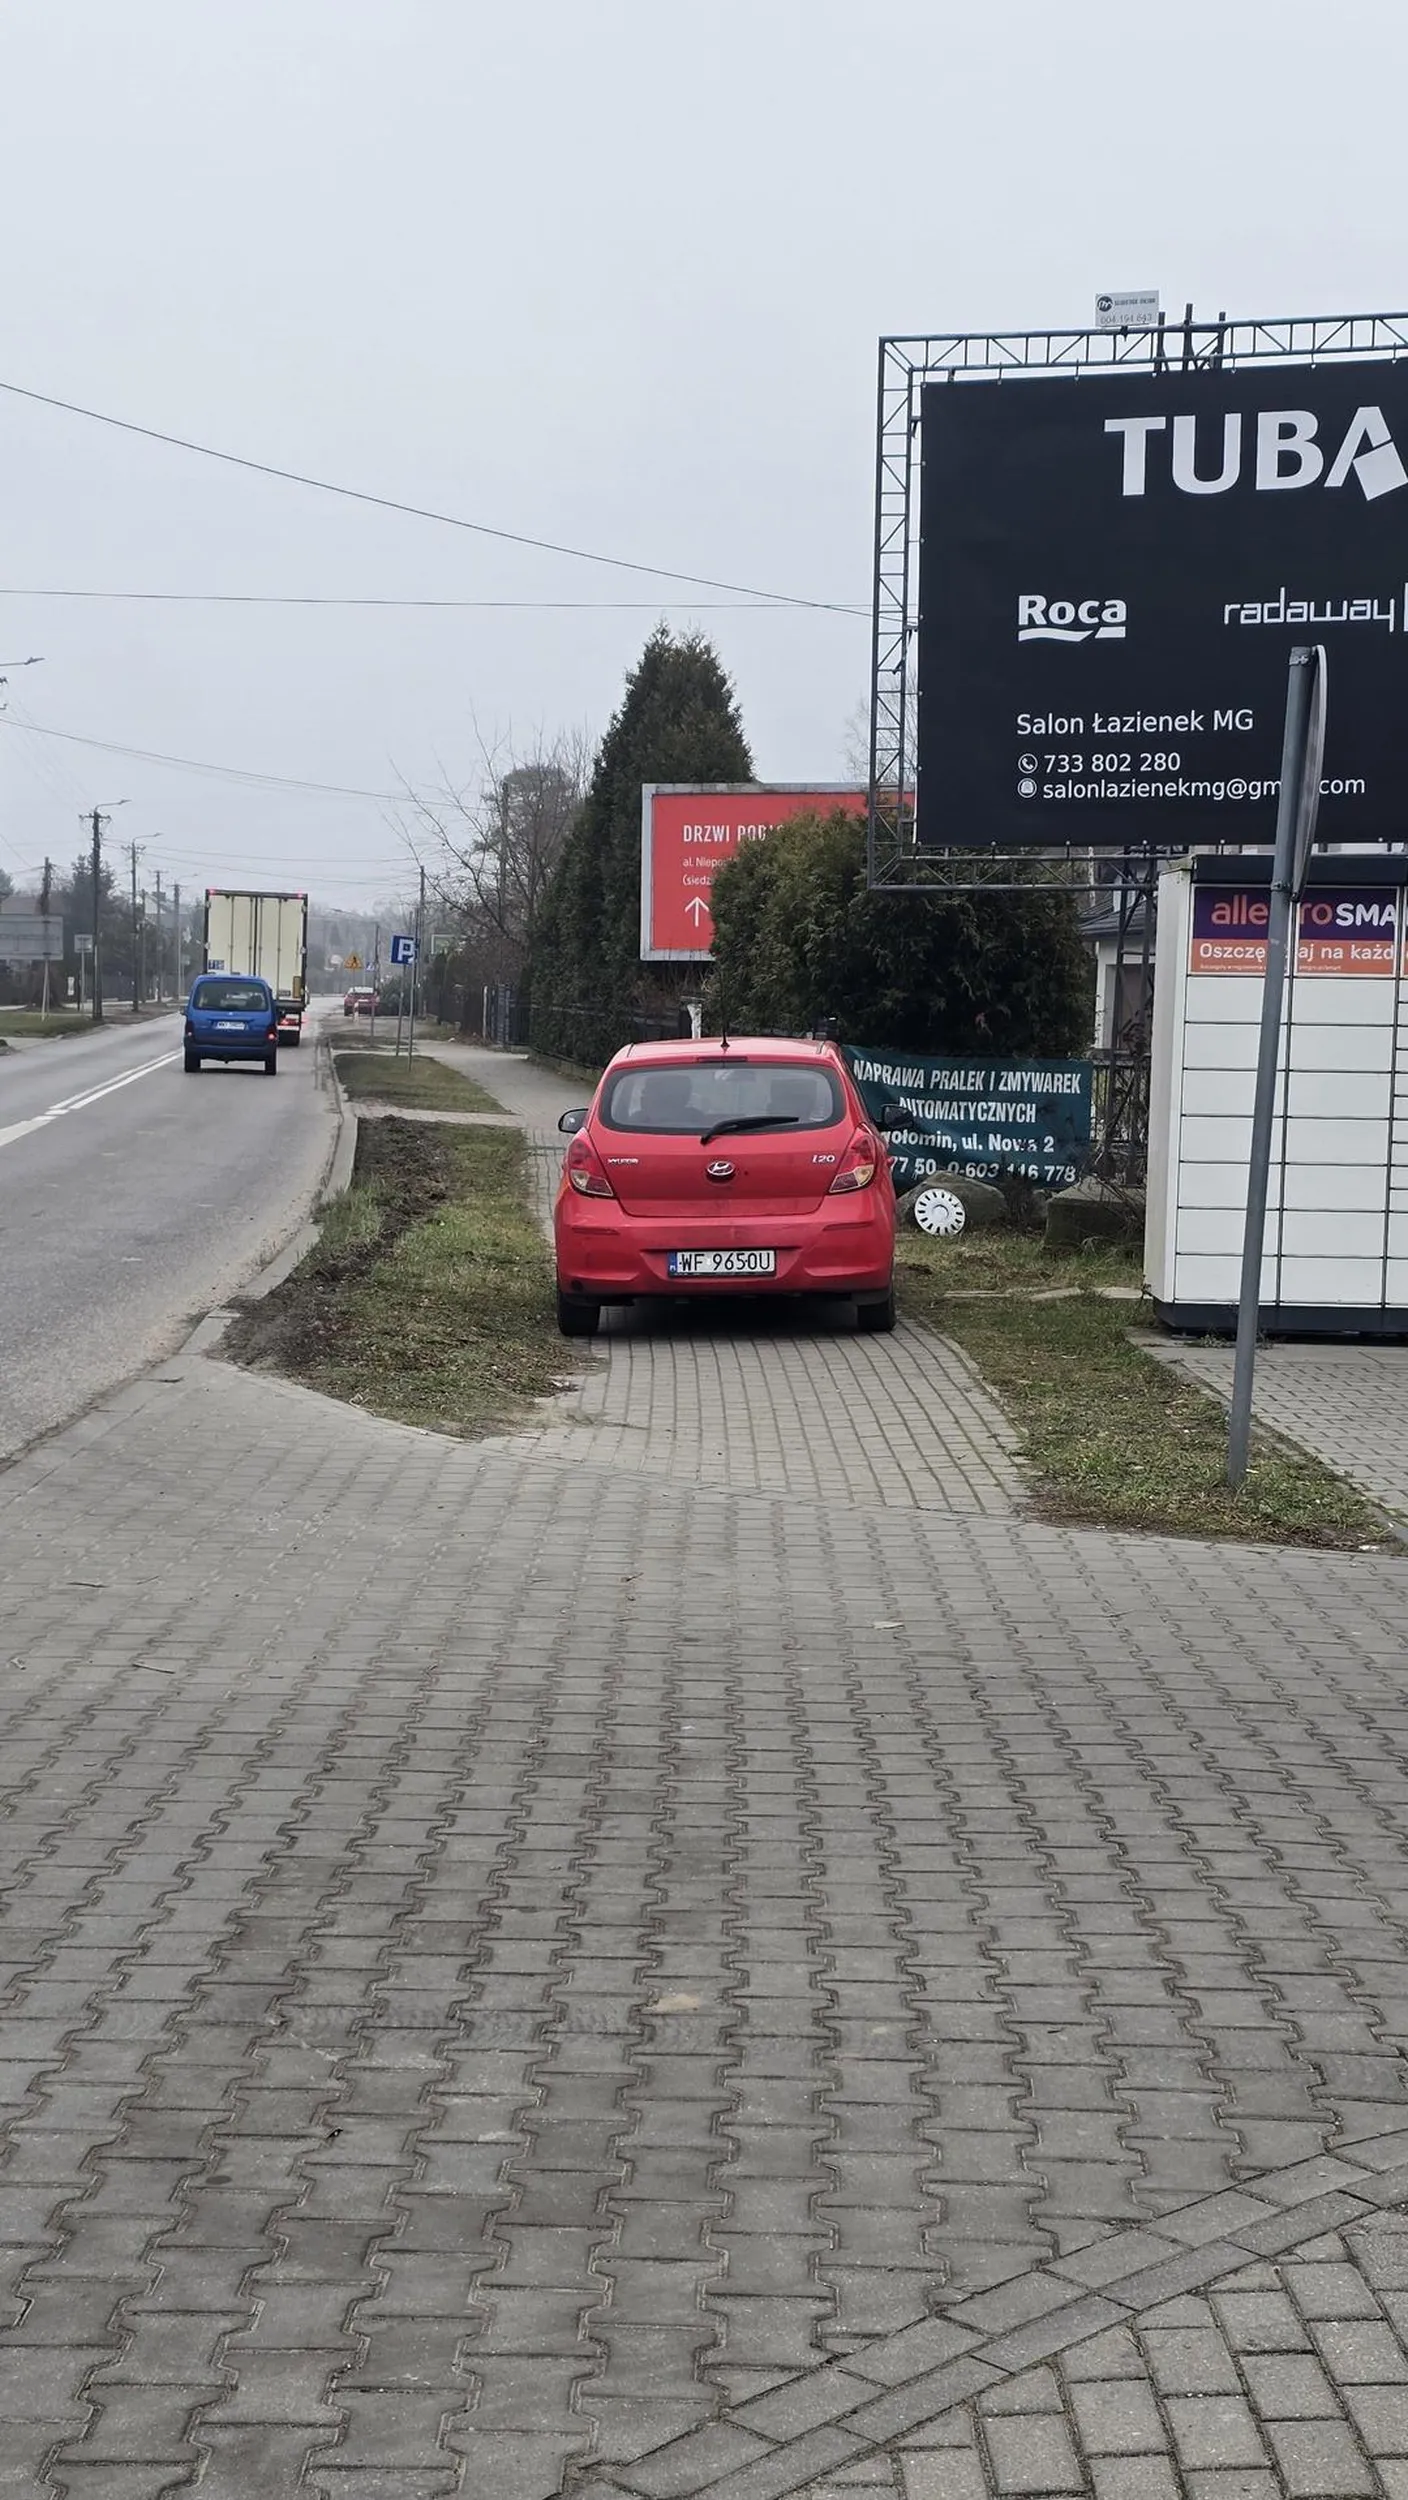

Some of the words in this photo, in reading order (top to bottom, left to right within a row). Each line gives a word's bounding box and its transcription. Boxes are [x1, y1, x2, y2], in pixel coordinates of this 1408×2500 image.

[1018, 595, 1127, 625] Roca
[1224, 587, 1395, 632] radaway
[1017, 713, 1084, 735] Salon
[1092, 710, 1204, 734] Łazienek
[1213, 709, 1253, 731] MG
[1044, 754, 1083, 773] 733
[1091, 753, 1131, 772] 802
[1140, 752, 1181, 771] 280
[1043, 777, 1365, 800] salonlazienekmg@gmcom
[683, 825, 730, 842] DRZWI
[738, 825, 785, 842] POD
[683, 874, 713, 886] (siedz
[1211, 894, 1333, 925] allero
[1336, 903, 1408, 926] SMA
[398, 938, 415, 963] P
[1200, 943, 1314, 962] Oszczęaj
[1321, 947, 1343, 959] na
[1351, 944, 1408, 960] każd
[853, 1060, 925, 1089] NAPRAWA
[930, 1070, 985, 1091] PRALEK
[989, 1071, 996, 1091] I
[998, 1071, 1081, 1094] ZMYWAREK
[900, 1097, 1036, 1123] AUTOMATYCZNYCH
[962, 1133, 983, 1150] ul.
[988, 1134, 1038, 1152] Nowa
[1043, 1136, 1054, 1153] 2
[915, 1158, 937, 1176] 50
[1044, 1165, 1076, 1182] 778
[681, 1253, 705, 1271] WF
[713, 1252, 770, 1271] 9650U
